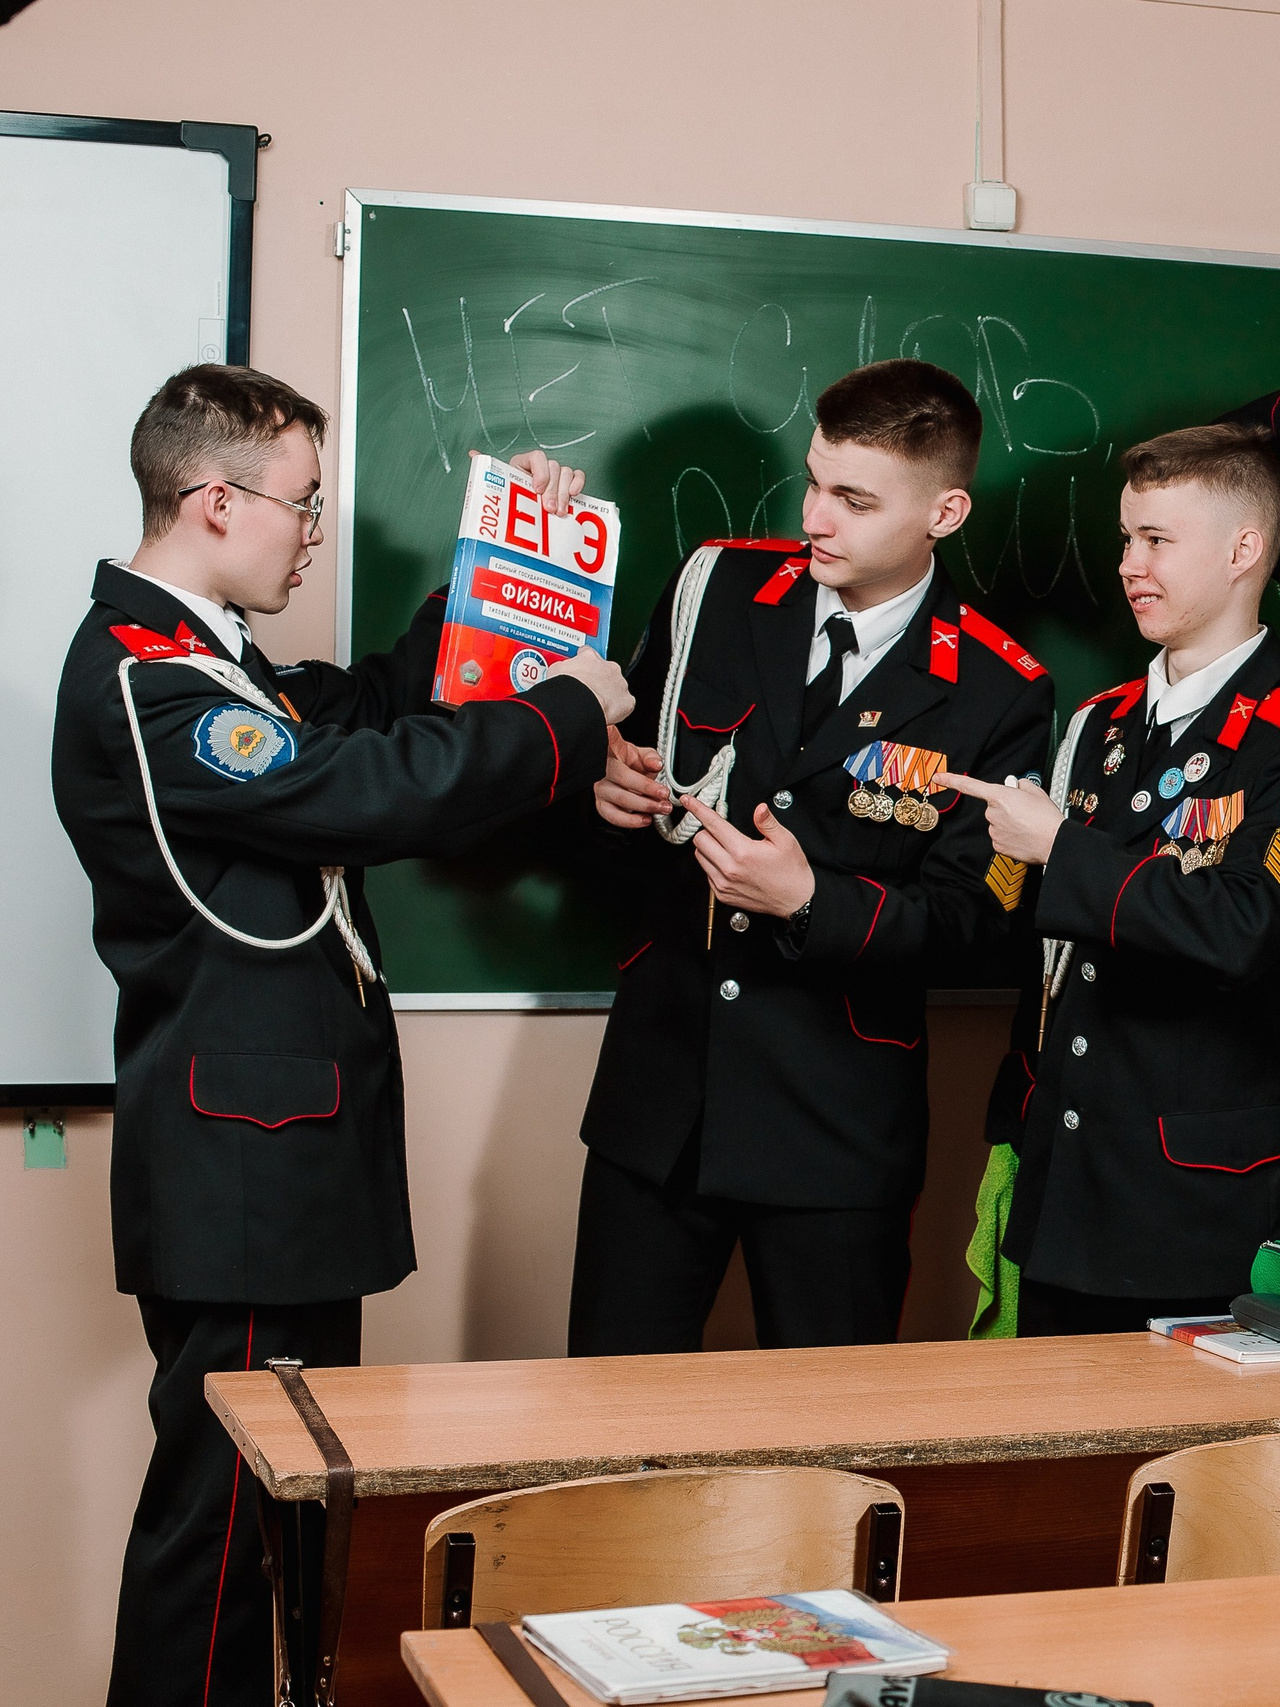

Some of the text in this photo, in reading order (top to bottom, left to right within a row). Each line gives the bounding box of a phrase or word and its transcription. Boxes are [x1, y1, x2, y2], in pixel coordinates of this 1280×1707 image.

[402, 275, 660, 475] НЕТ
[479, 494, 501, 539] 2024
[504, 481, 608, 574] ЕГЭ
[494, 562, 586, 598] ЕДИНЫЙ ГОСУДАРСТВЕННЫЙ ЭКЗАМЕН
[501, 582, 576, 623] ФИЗИКА
[488, 606, 581, 641] ТИПОВЫЕ ЭКЗАМЕНАЦИОННЫЕ ВАРИАНТЫ
[521, 663, 539, 680] 30
